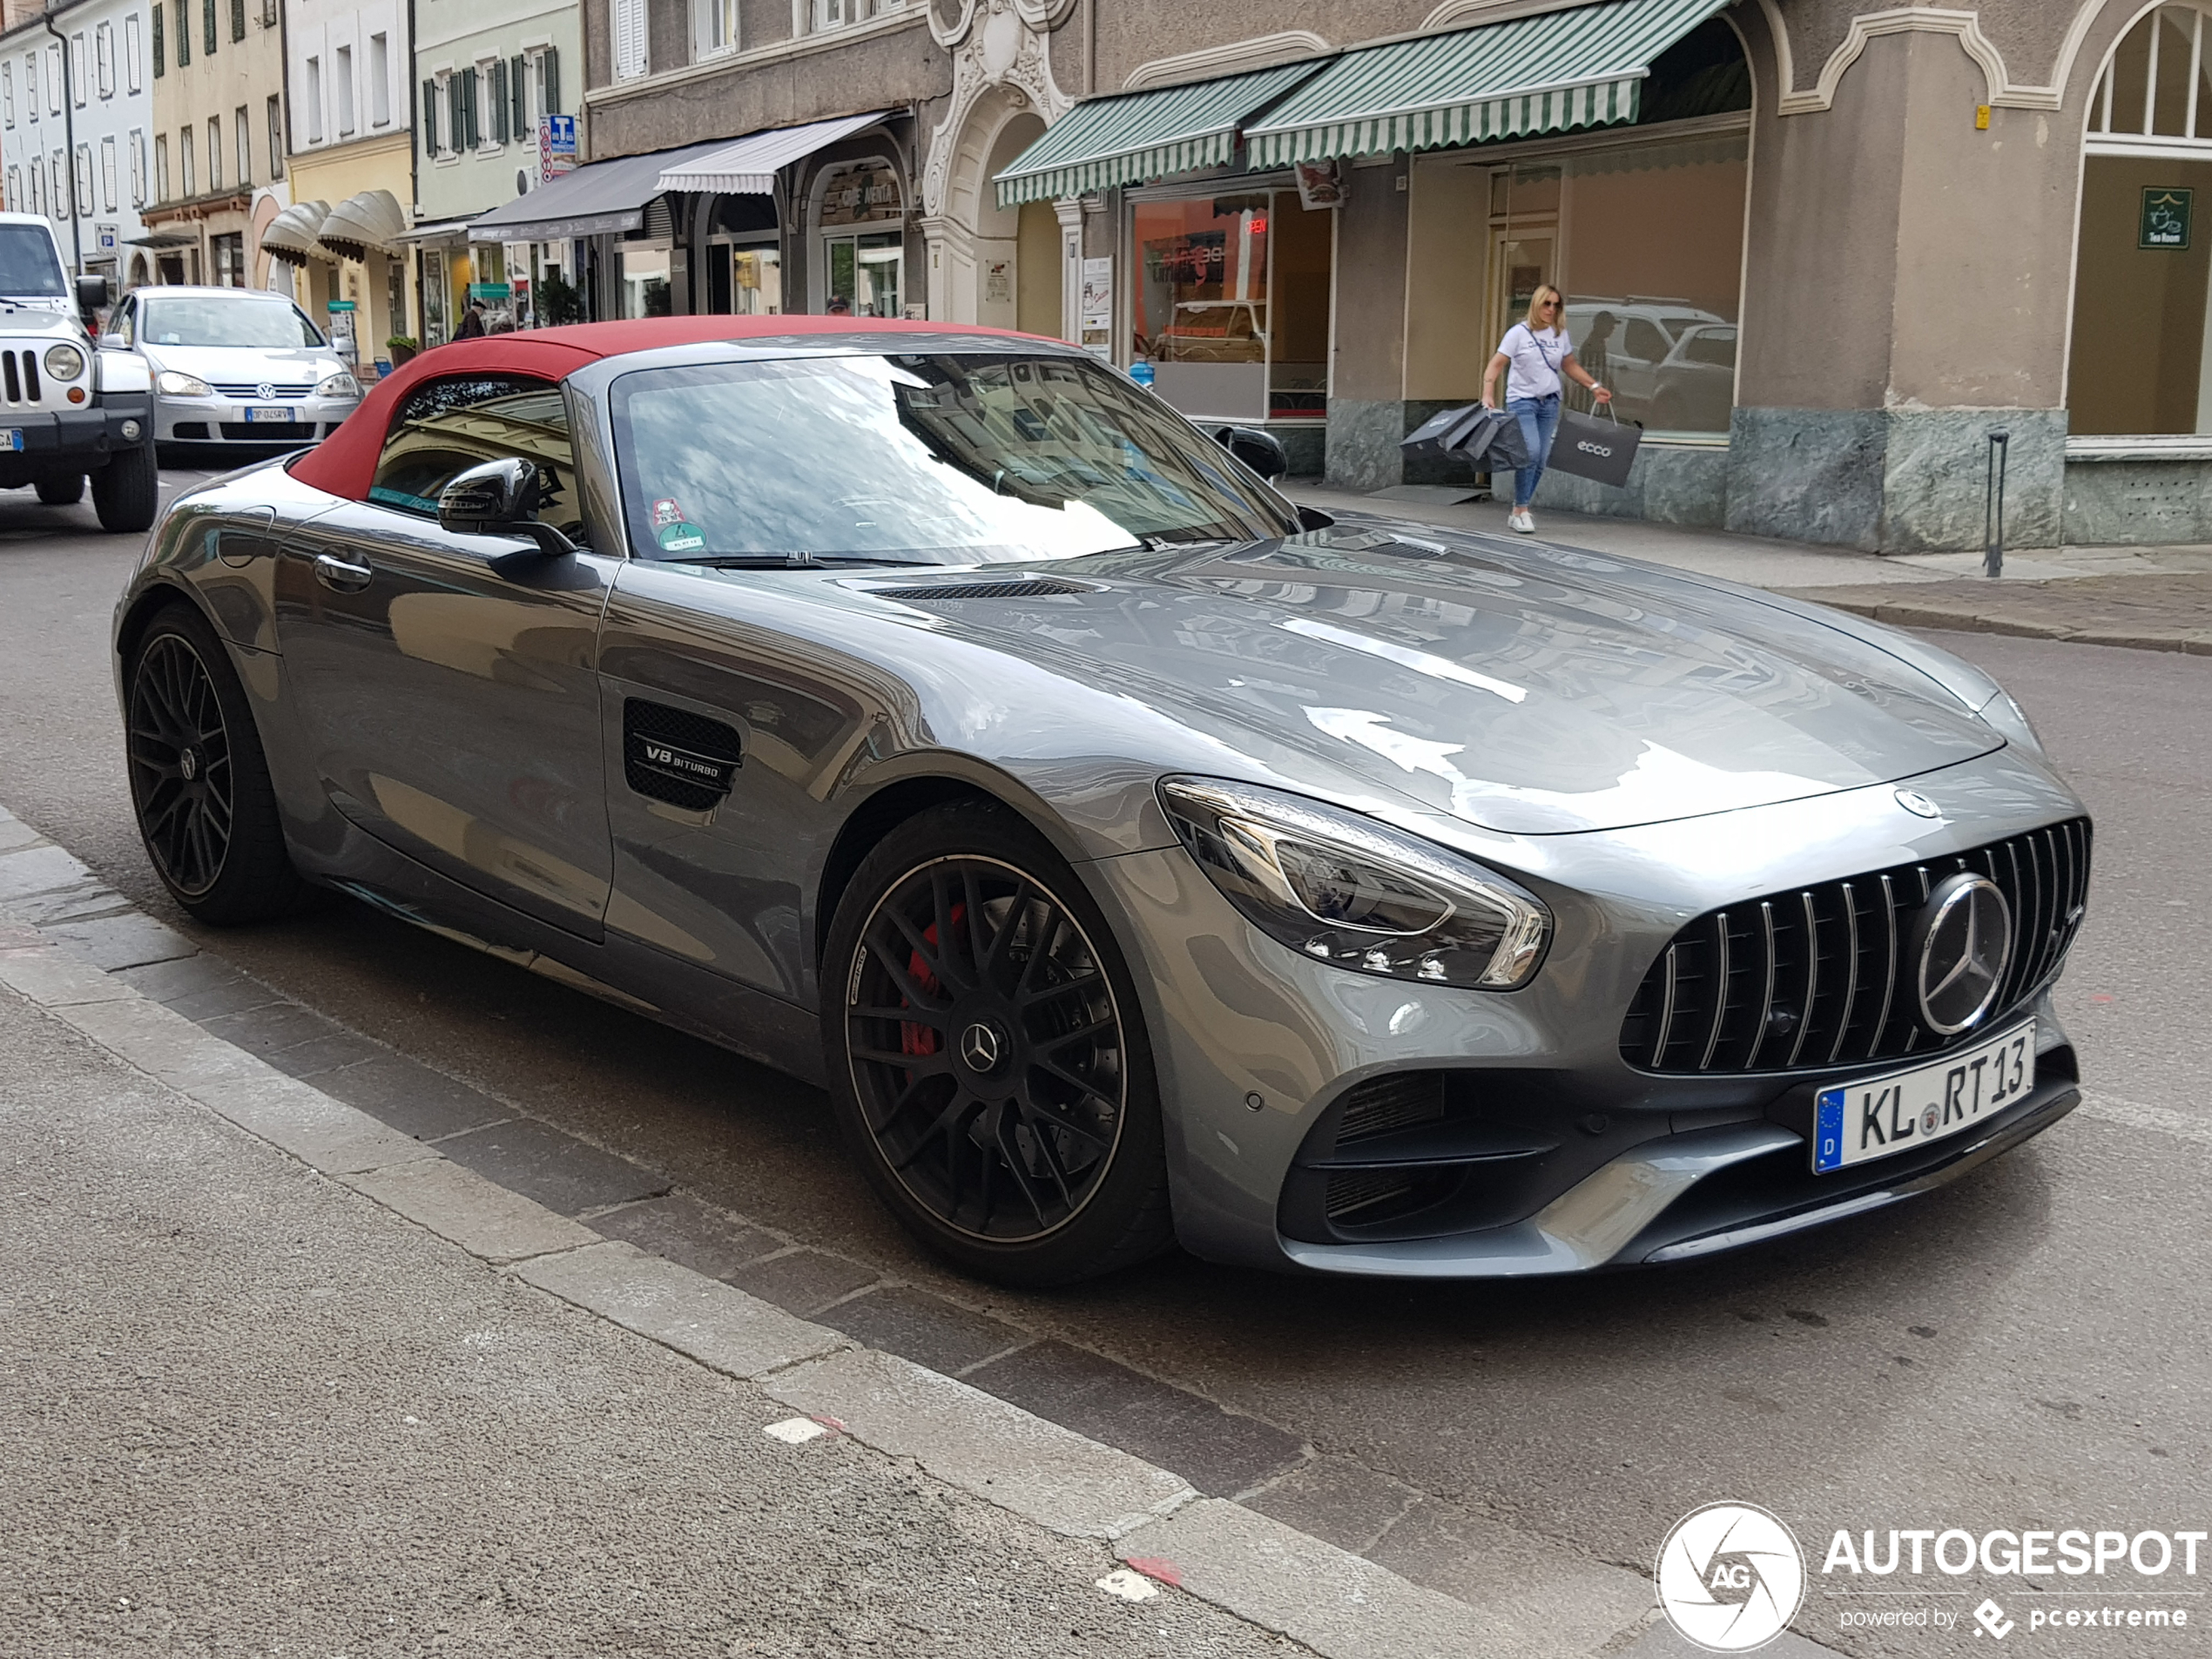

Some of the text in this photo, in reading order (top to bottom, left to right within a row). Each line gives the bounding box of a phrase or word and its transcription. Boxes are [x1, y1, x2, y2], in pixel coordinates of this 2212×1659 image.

[555, 117, 570, 141] T
[1245, 219, 1267, 235] OPEN
[104, 236, 111, 246] P
[1577, 441, 1611, 457] ecco
[646, 745, 718, 778] V8 BITURBO
[1861, 1085, 1915, 1150] KL
[1824, 1138, 1835, 1156] D
